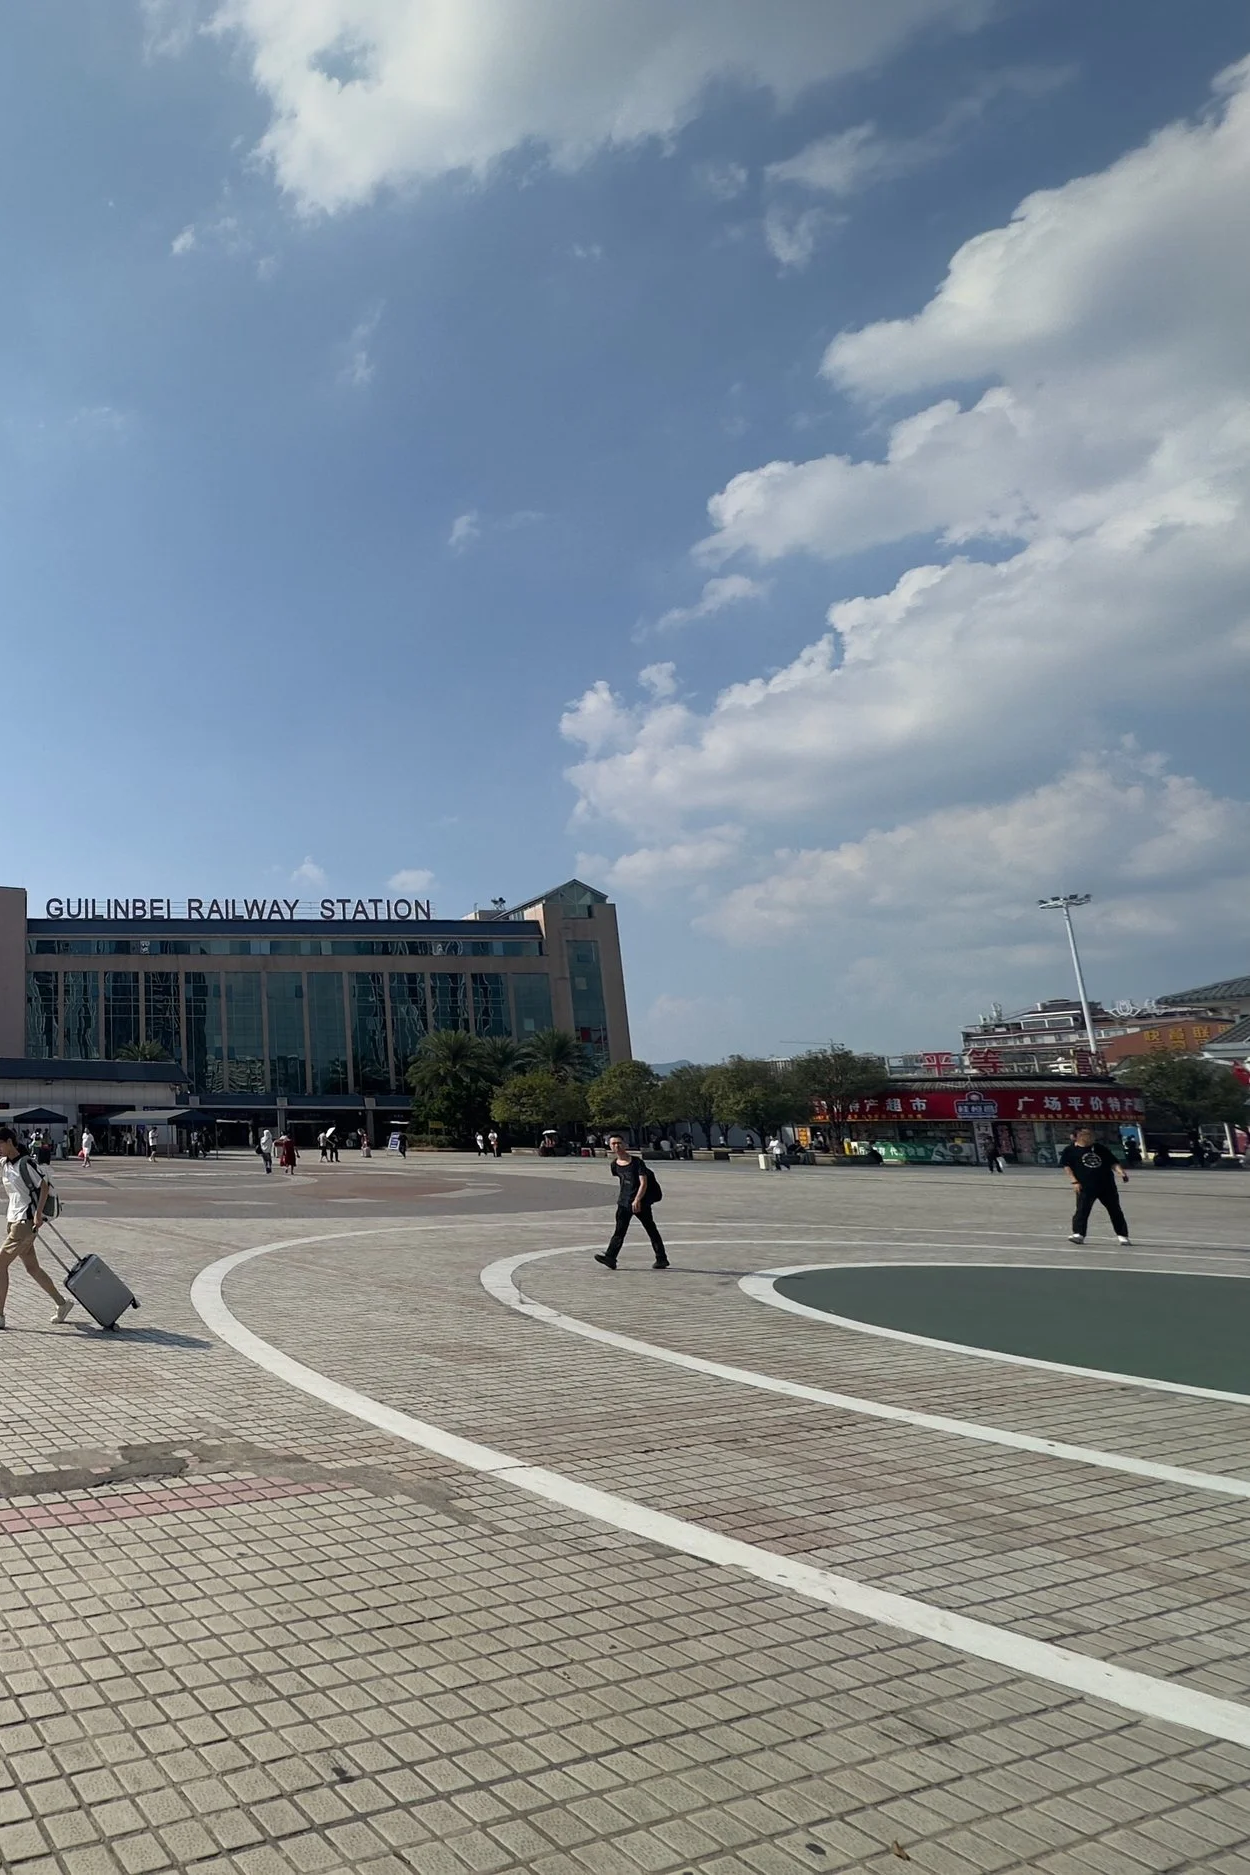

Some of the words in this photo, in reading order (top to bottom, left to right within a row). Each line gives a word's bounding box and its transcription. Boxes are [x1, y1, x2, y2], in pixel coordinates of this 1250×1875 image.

[45, 898, 171, 920] GUILINBEI
[187, 898, 300, 920] RAILWAY
[319, 898, 432, 920] STATION
